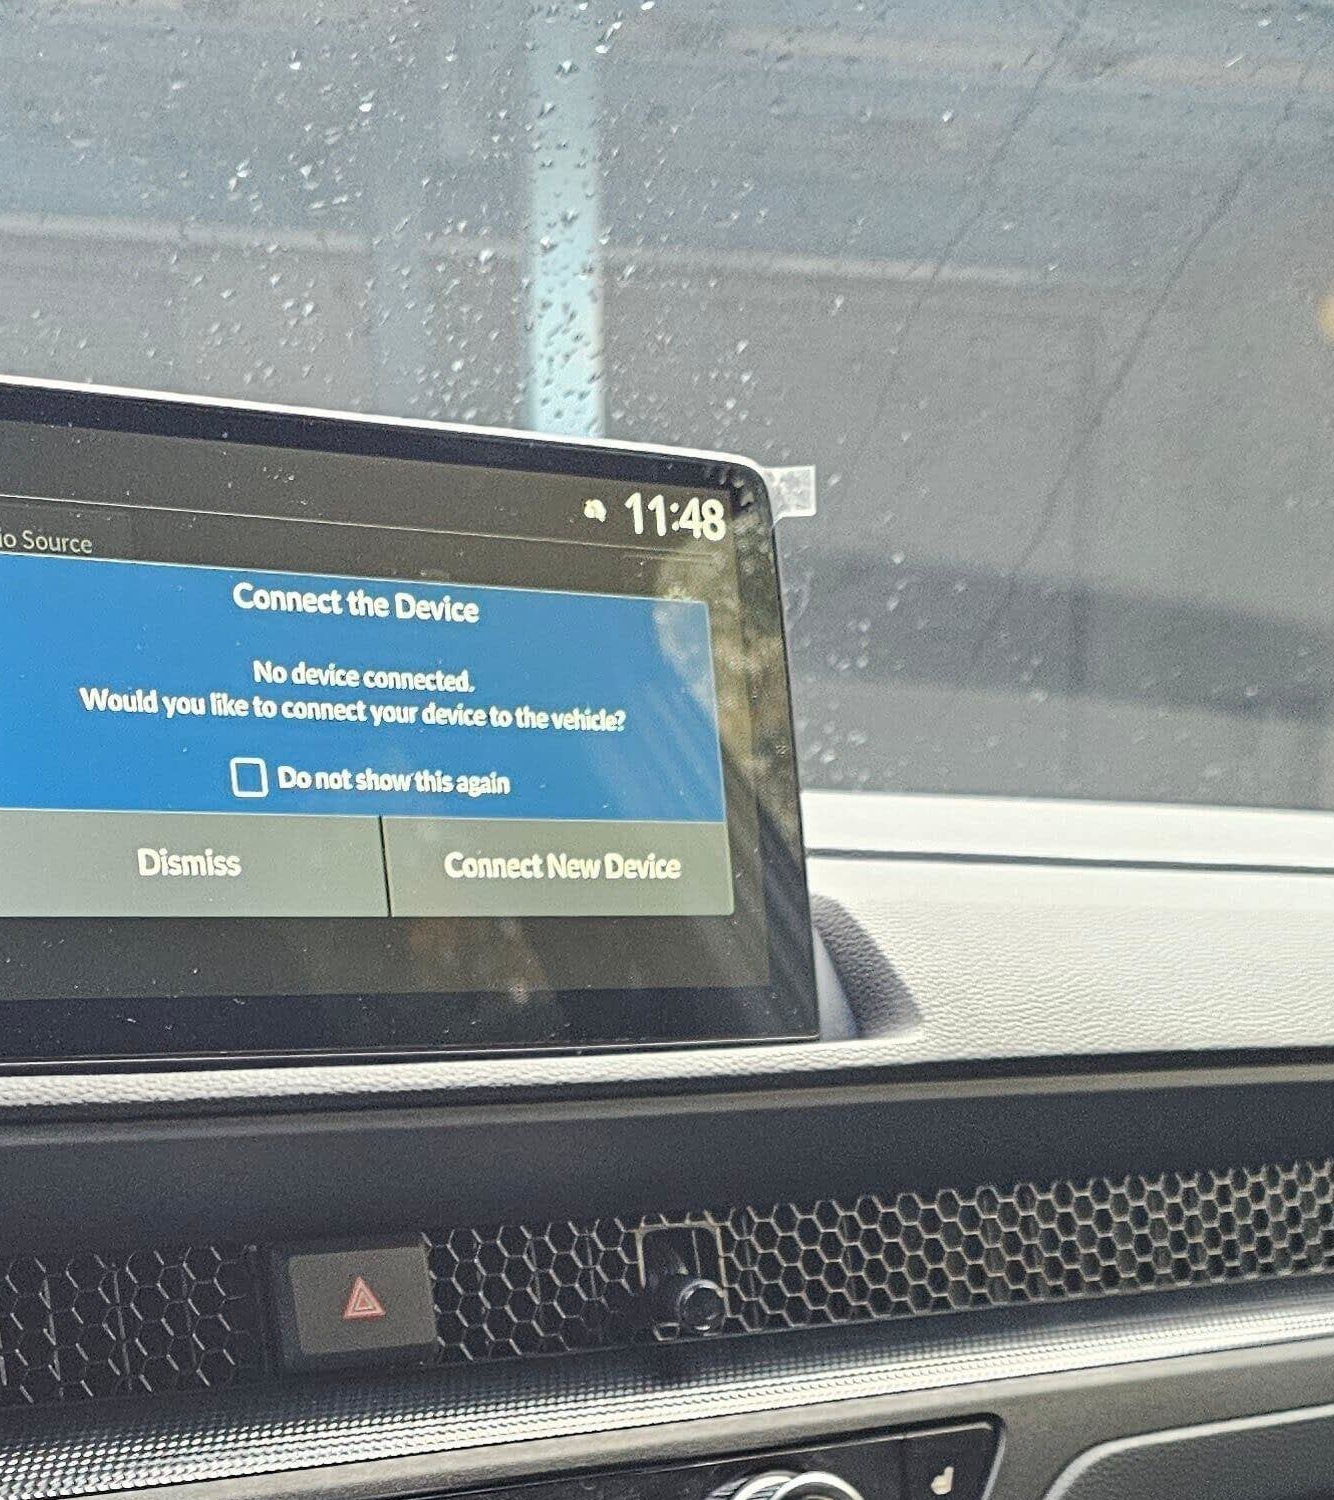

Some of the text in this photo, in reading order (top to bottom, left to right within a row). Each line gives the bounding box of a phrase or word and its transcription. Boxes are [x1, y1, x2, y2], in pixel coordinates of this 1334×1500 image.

[624, 491, 727, 542] 11:48
[22, 528, 93, 554] Source
[232, 581, 480, 624] Connect the Device
[253, 660, 476, 693] No device connected.
[78, 687, 627, 733] Would you like to connect your device to the vehicle?
[278, 766, 511, 797] Do not show this again
[137, 848, 242, 878] Dismiss
[443, 853, 682, 881] Connect New Device
